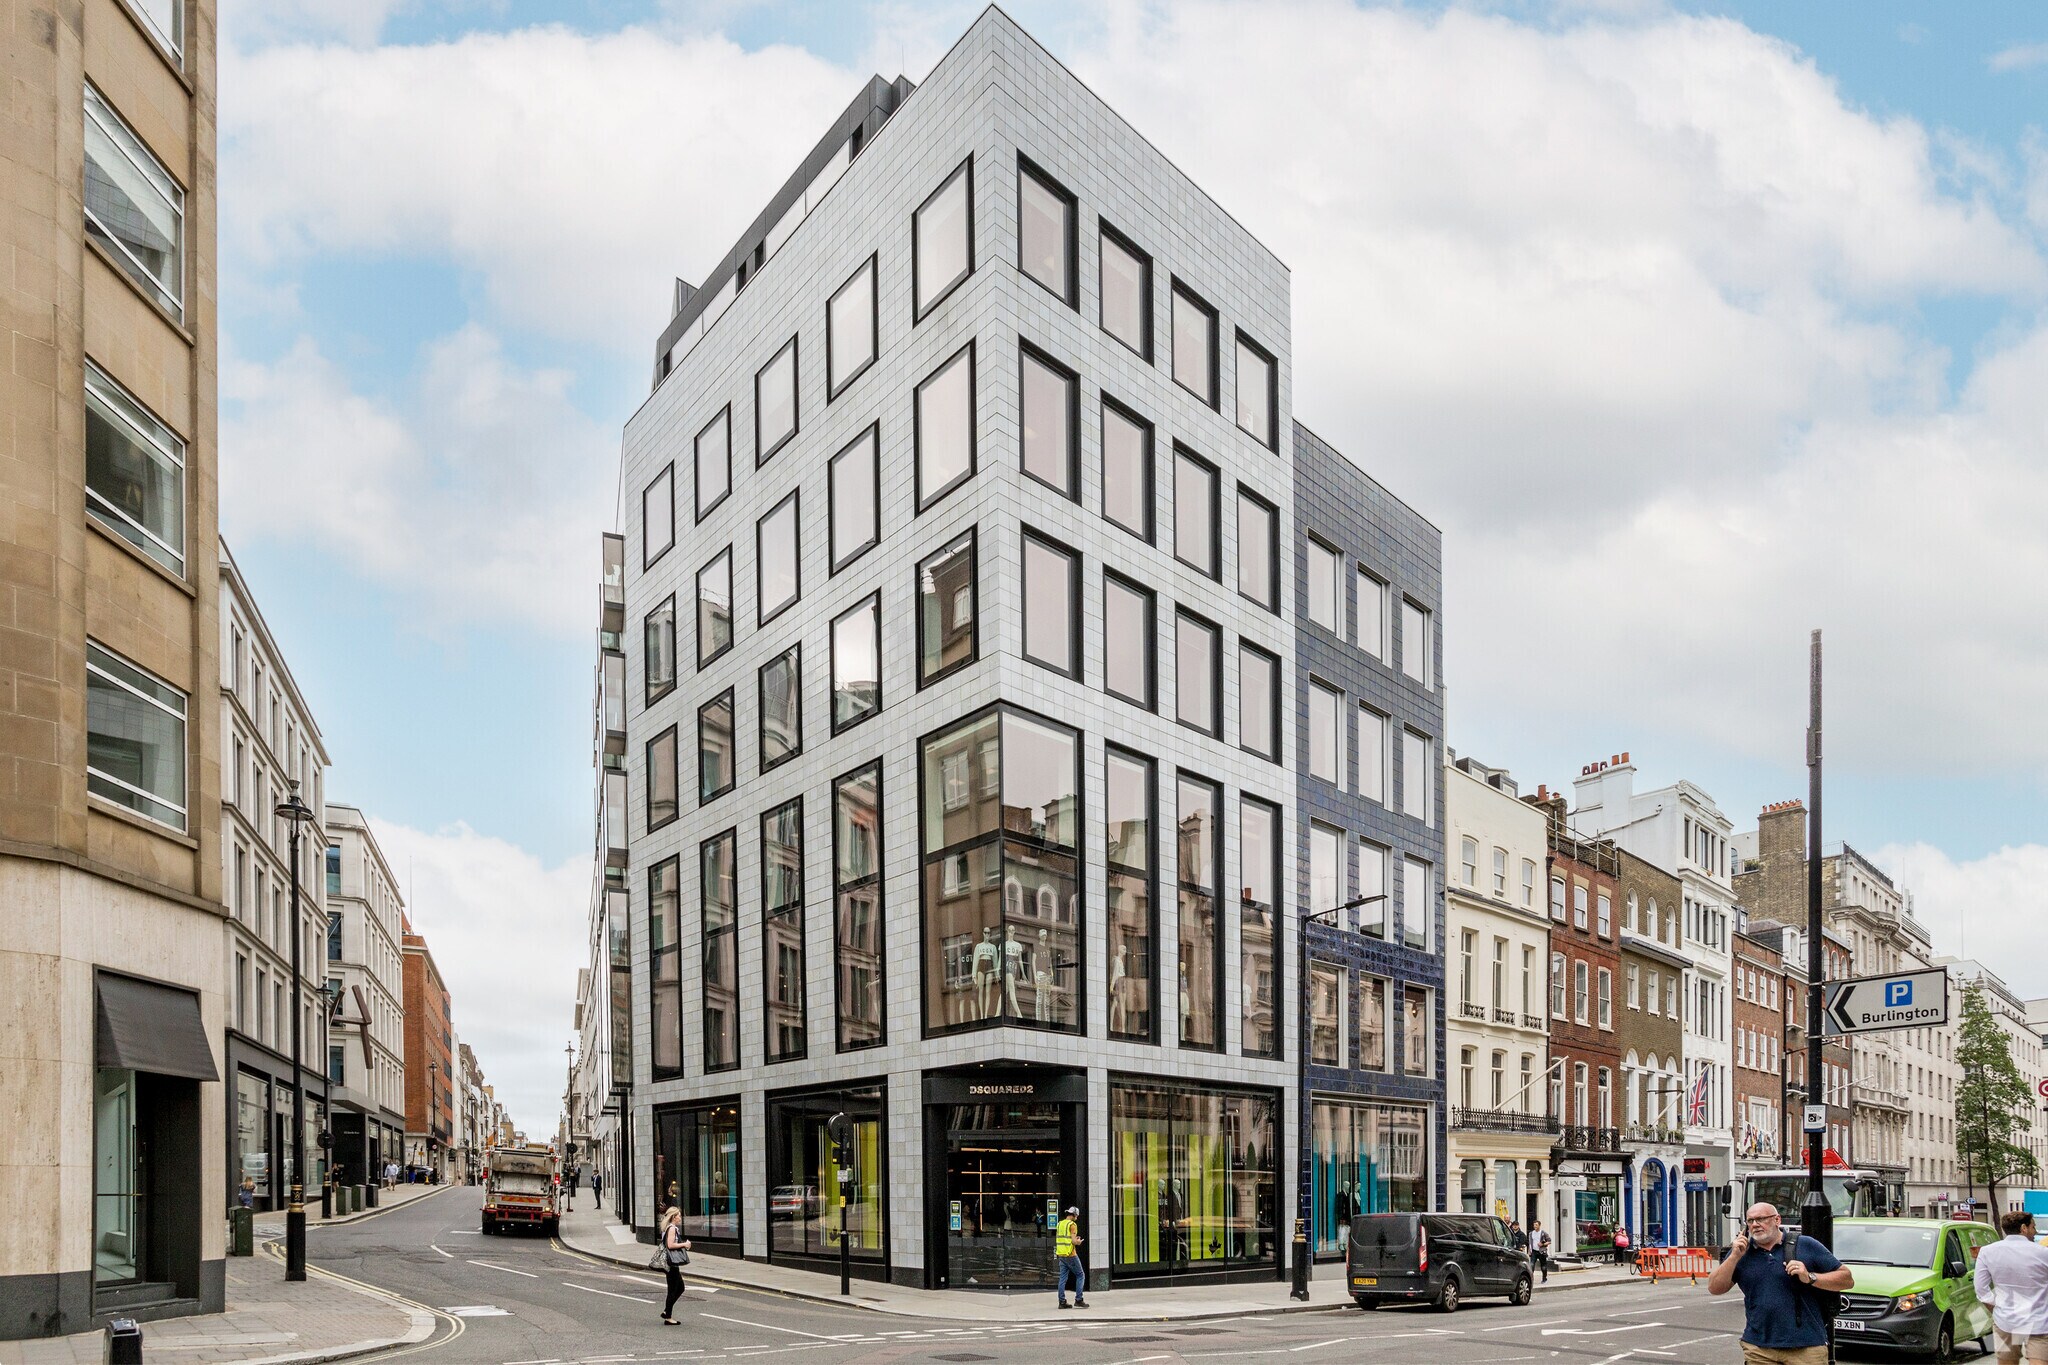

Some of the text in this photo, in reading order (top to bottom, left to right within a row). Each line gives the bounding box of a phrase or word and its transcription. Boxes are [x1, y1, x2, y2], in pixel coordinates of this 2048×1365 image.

[1891, 984, 1909, 1005] P
[1862, 1008, 1939, 1024] Burlington
[969, 1085, 1034, 1095] DSQUARED2
[1844, 1321, 1861, 1329] XBN
